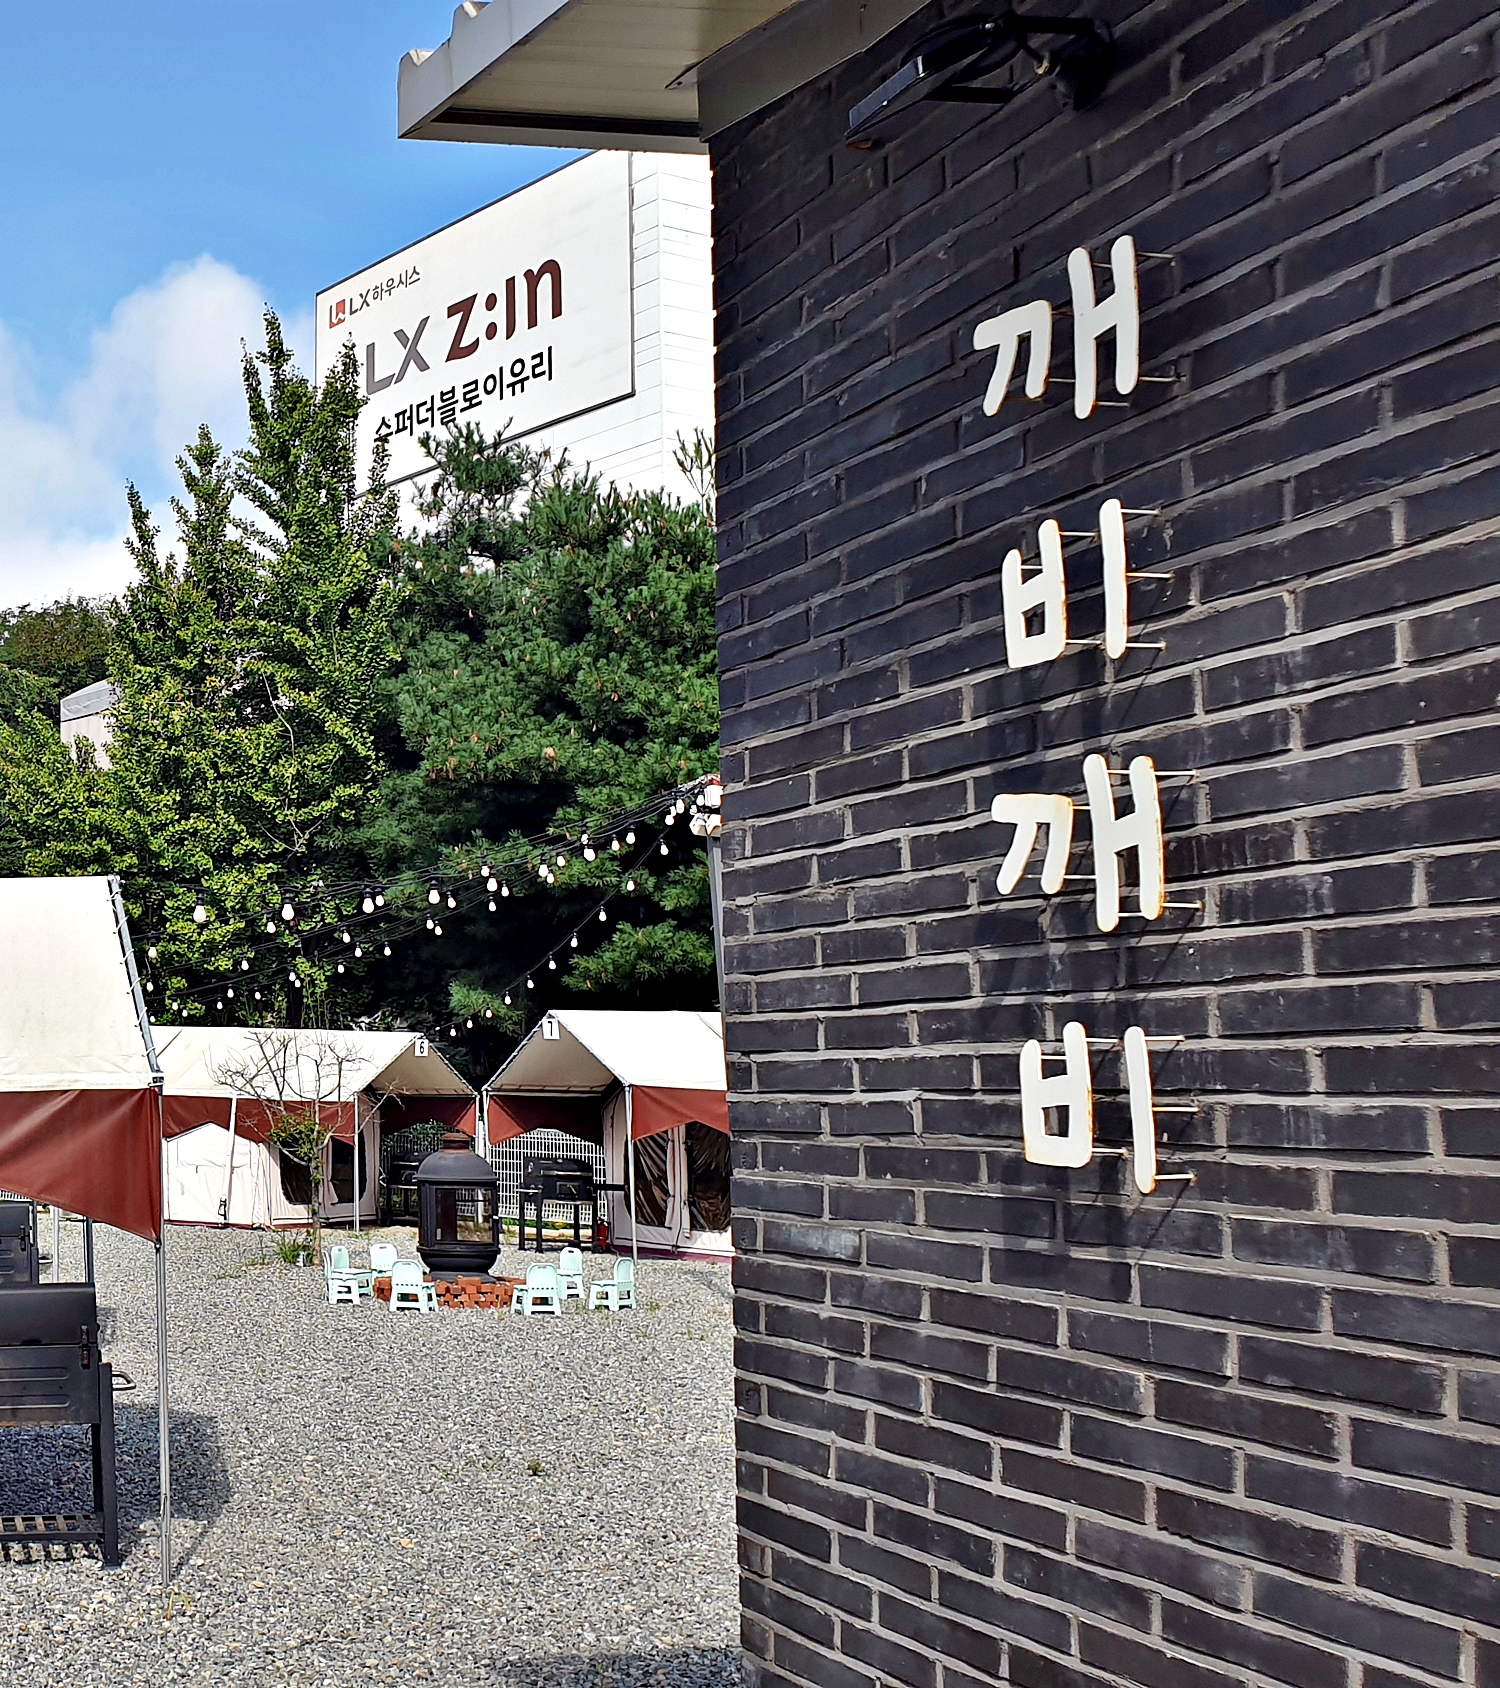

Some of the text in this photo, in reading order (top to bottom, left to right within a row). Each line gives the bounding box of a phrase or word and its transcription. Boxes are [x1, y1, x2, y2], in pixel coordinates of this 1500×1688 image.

[366, 315, 430, 395] LX
[973, 234, 1164, 1194] 깨비깨비
[419, 1041, 425, 1055] 6
